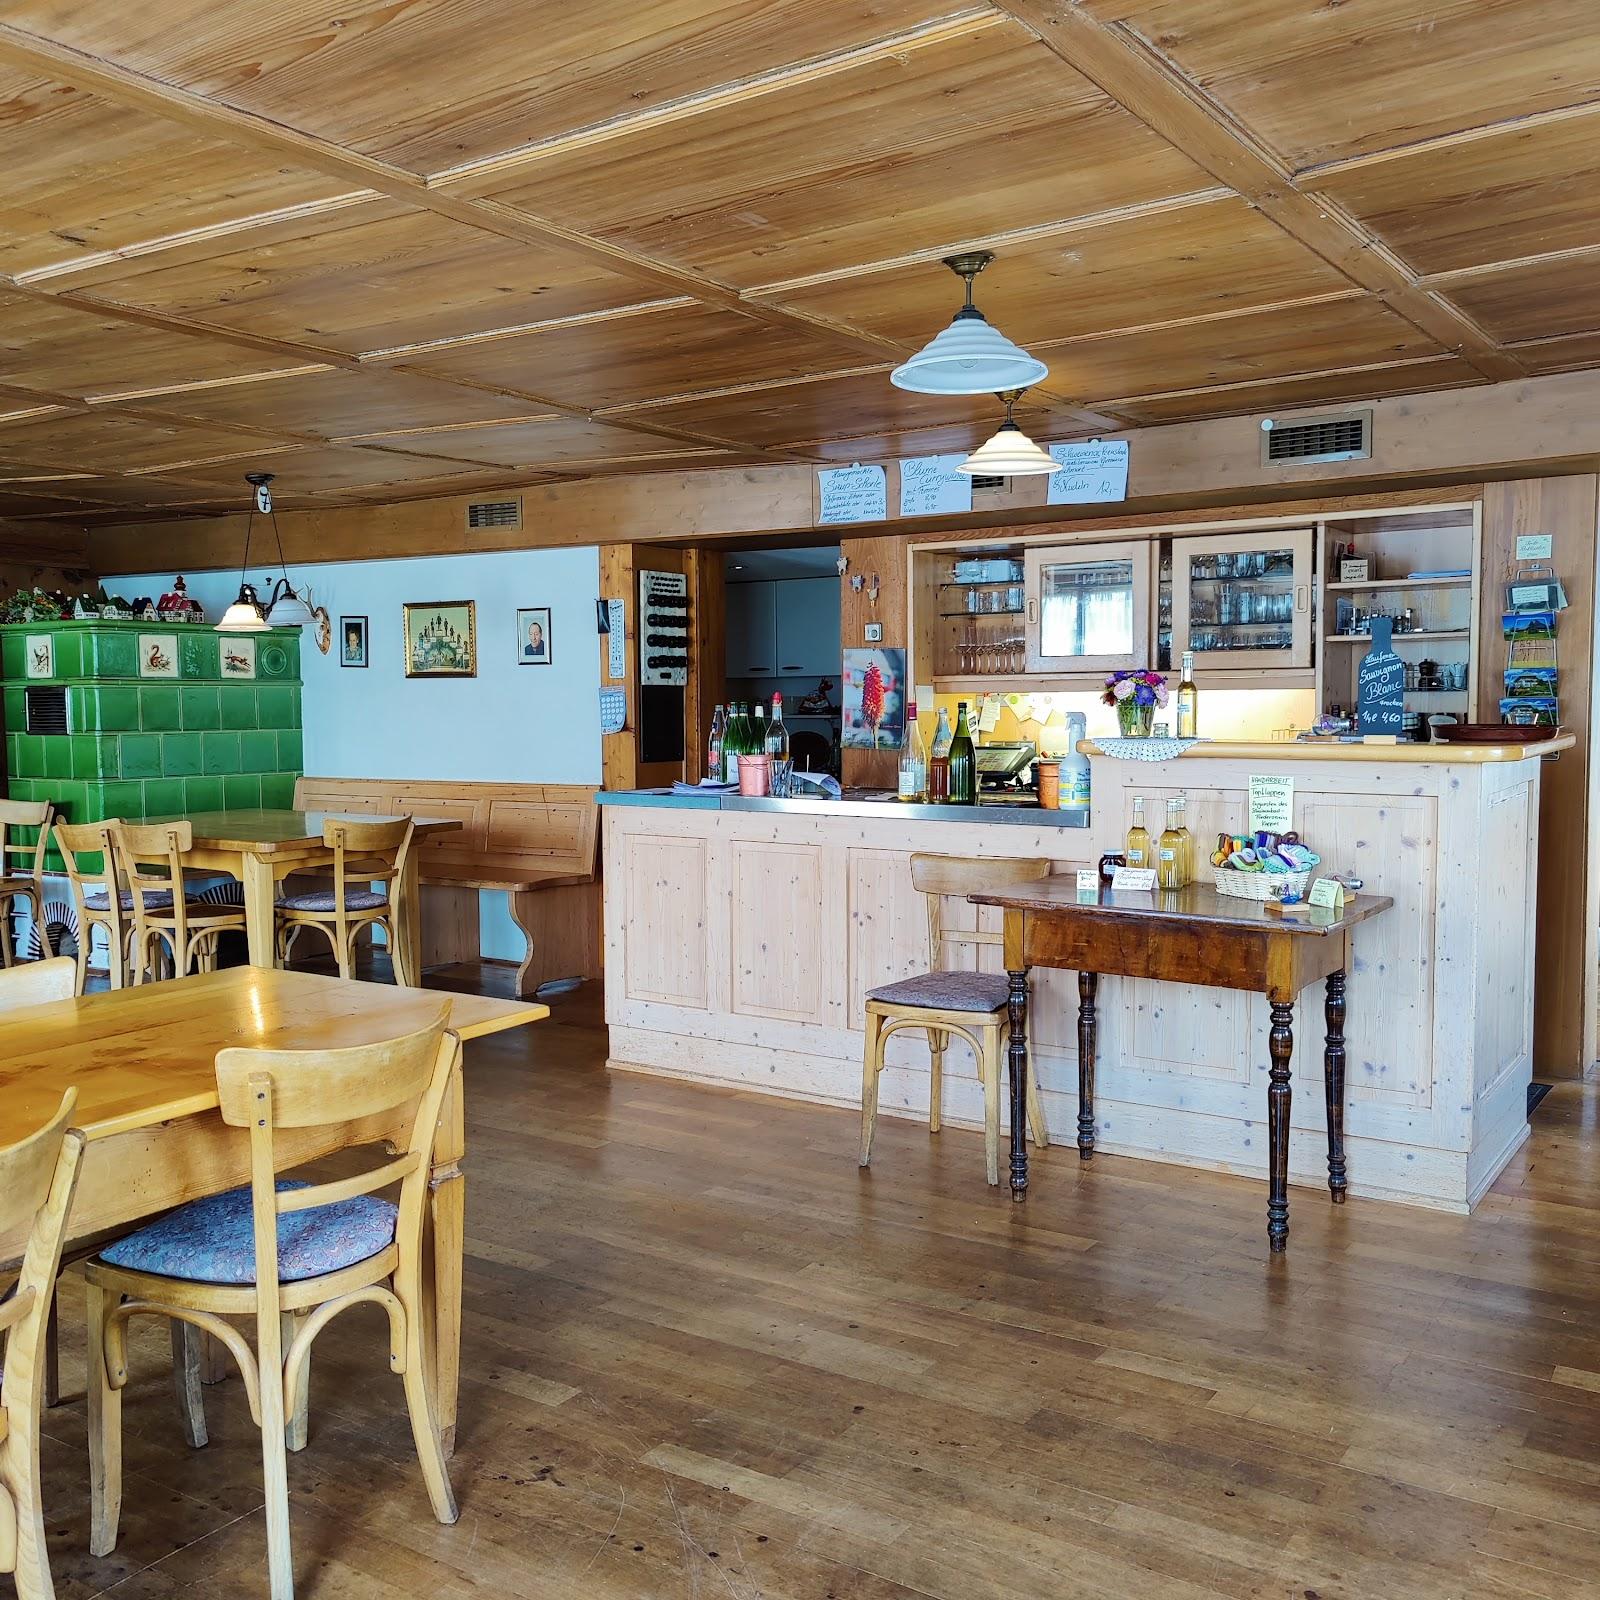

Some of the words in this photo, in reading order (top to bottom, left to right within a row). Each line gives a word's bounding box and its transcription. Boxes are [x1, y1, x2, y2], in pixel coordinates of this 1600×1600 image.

[1060, 477, 1089, 492] Nudeln
[1359, 662, 1403, 684] Sauvignon
[1365, 681, 1402, 701] Blanc
[1379, 698, 1404, 708] trocken
[1381, 711, 1401, 724] 4,60
